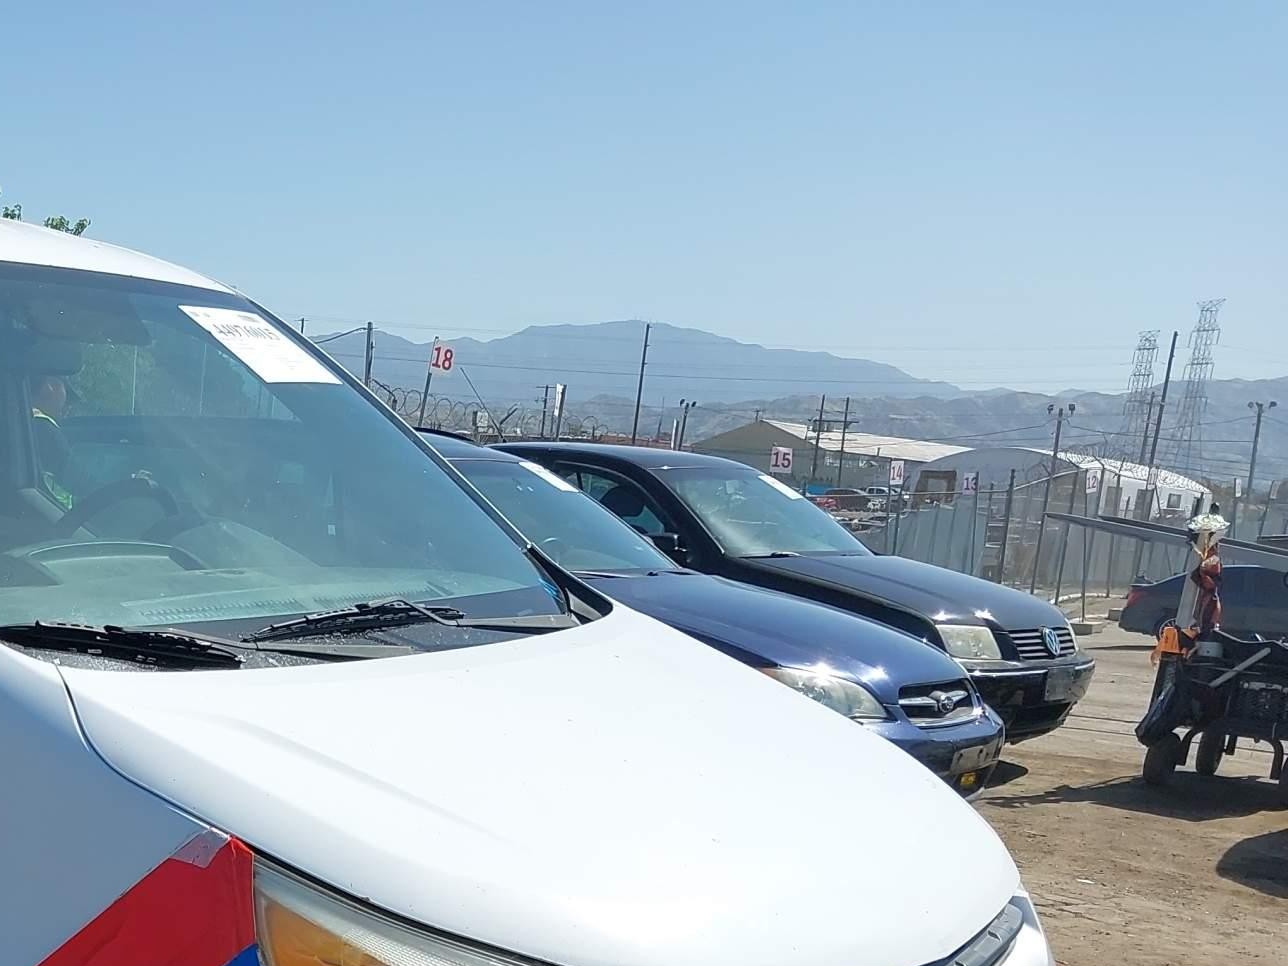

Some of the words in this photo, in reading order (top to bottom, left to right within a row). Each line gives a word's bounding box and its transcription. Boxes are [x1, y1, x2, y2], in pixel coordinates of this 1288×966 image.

[432, 346, 453, 370] 18
[772, 451, 791, 468] 15
[891, 464, 903, 481] 14
[964, 477, 977, 490] 13
[1087, 475, 1097, 489] 12
